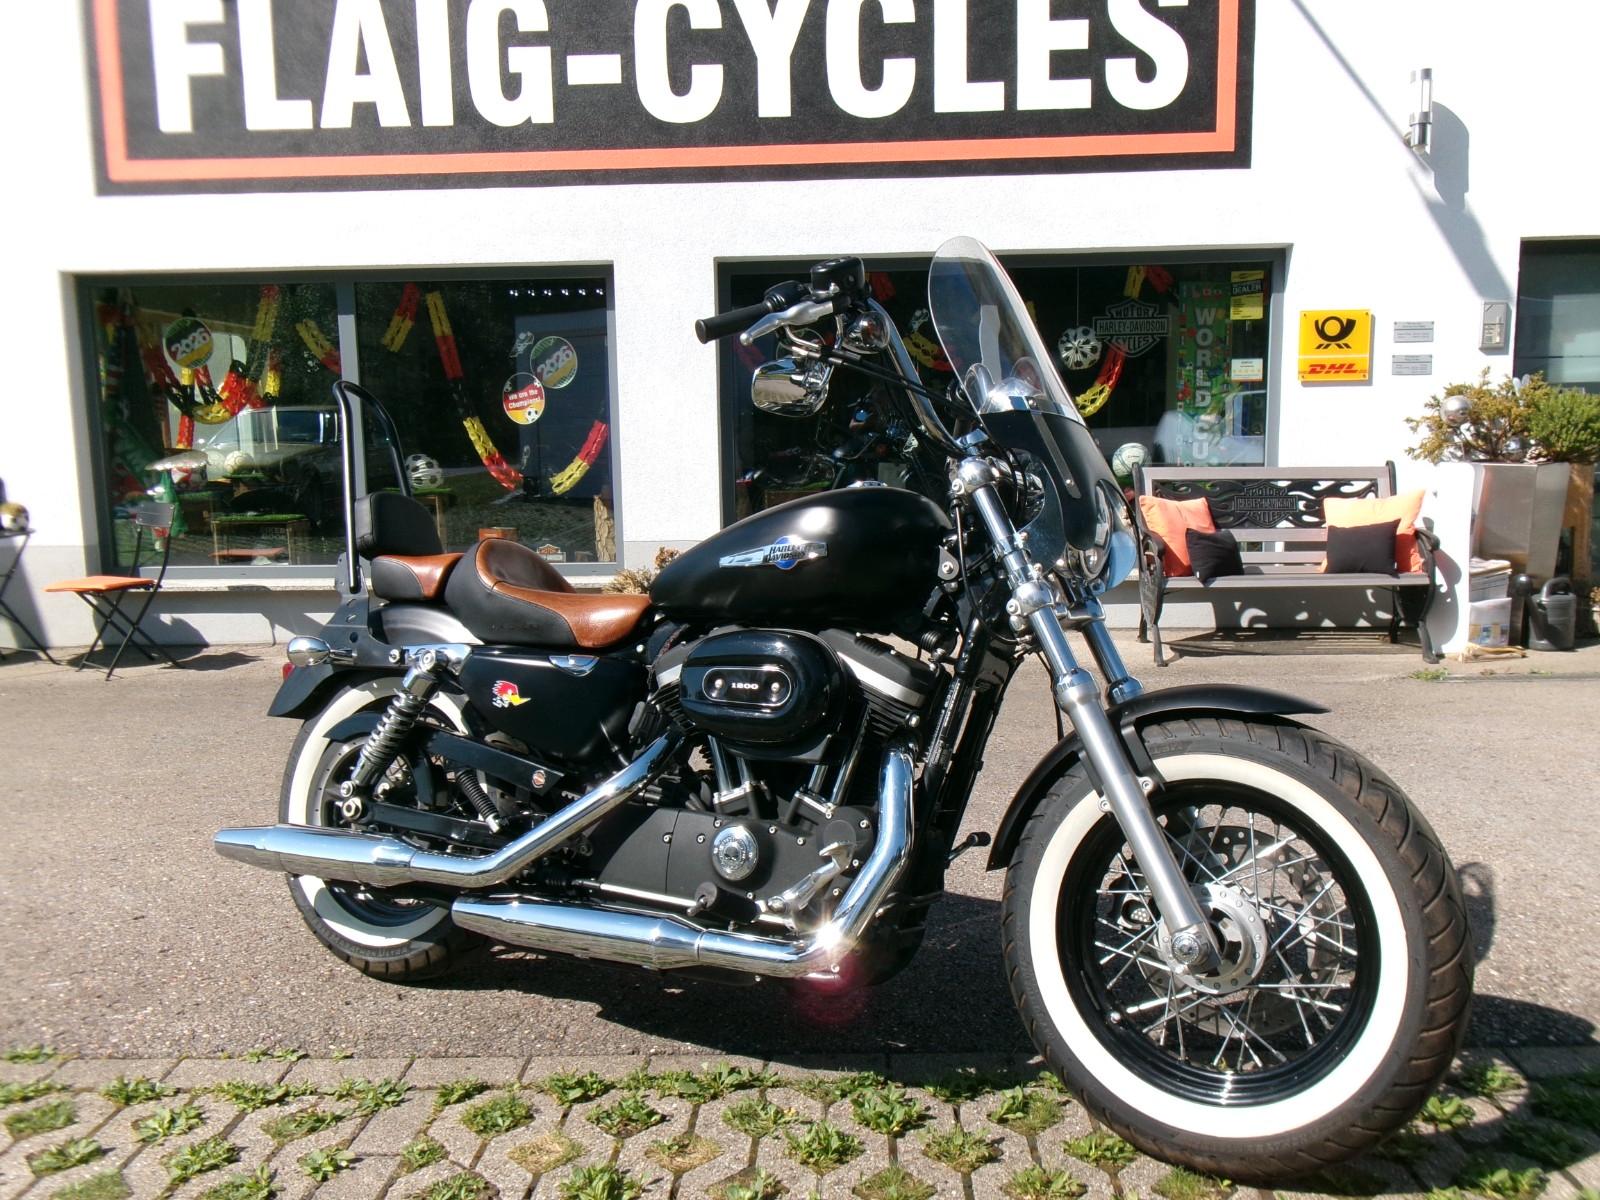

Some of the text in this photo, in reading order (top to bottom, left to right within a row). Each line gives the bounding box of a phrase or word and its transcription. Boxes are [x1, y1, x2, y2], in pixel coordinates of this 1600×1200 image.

[149, 0, 1190, 134] FLAIG-CYCLES
[1099, 320, 1166, 333] HARLEY-DAVIDSON
[1308, 363, 1359, 375] DHL
[1192, 307, 1217, 460] WORLD CU
[731, 682, 759, 690] 1200
